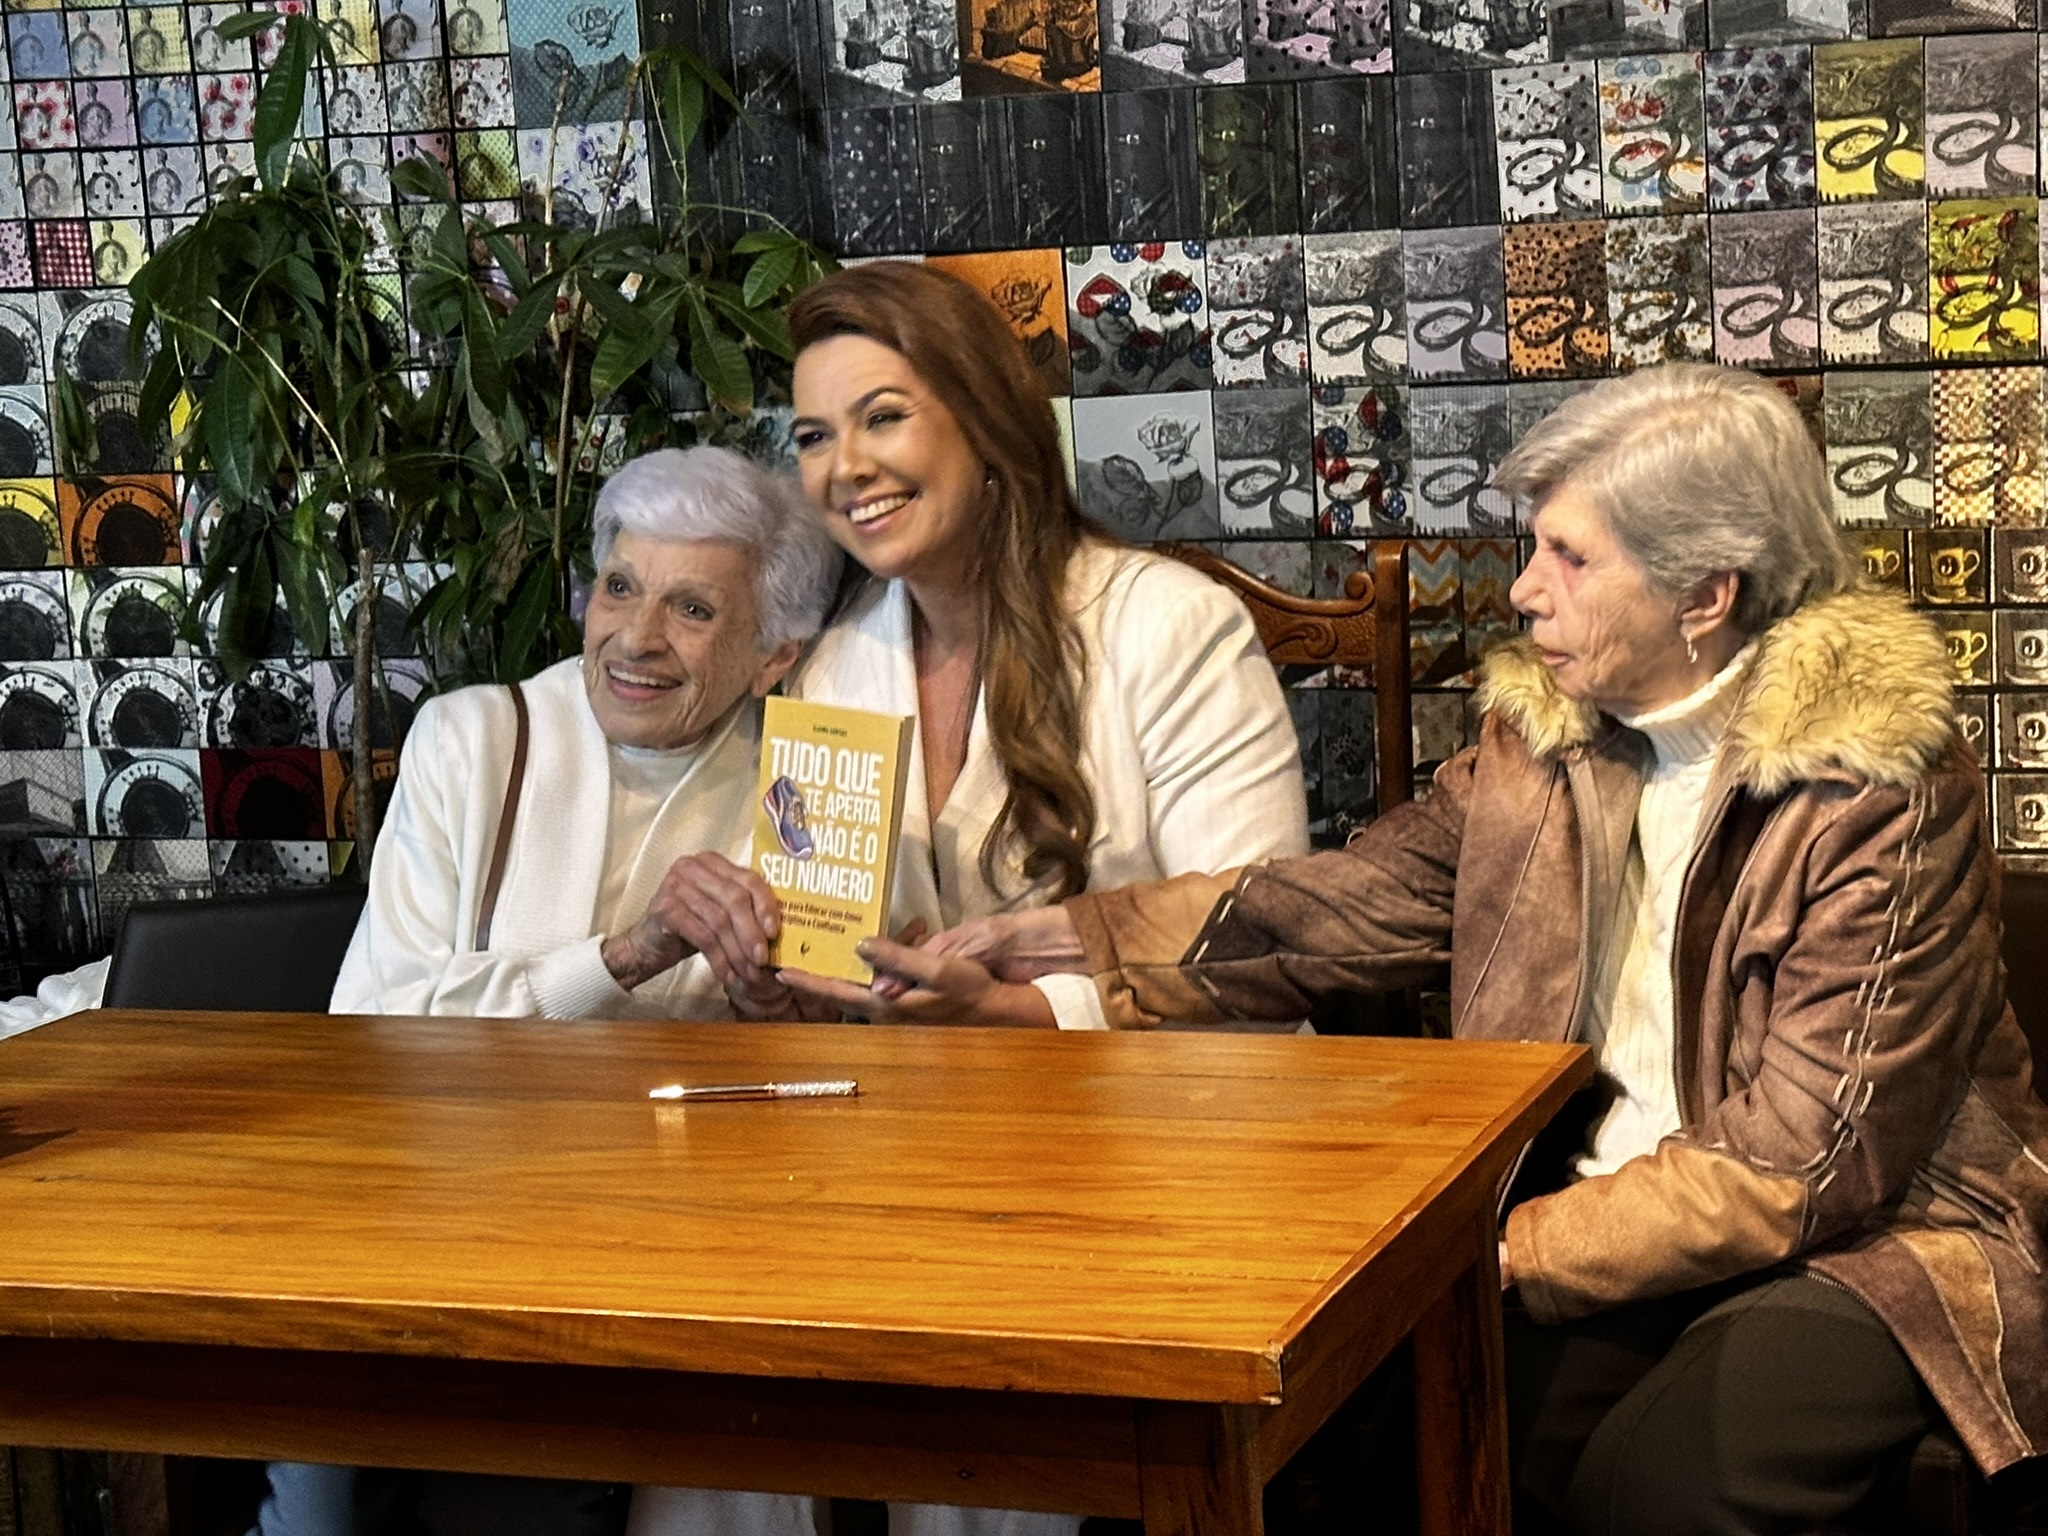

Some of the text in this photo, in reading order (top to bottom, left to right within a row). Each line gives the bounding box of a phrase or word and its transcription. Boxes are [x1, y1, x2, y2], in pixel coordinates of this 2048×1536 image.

[770, 737, 884, 797] TUDO QUE
[805, 786, 881, 826] TE APERTA
[810, 819, 878, 865] NÃO É O
[760, 850, 874, 904] SEU NÚMERO
